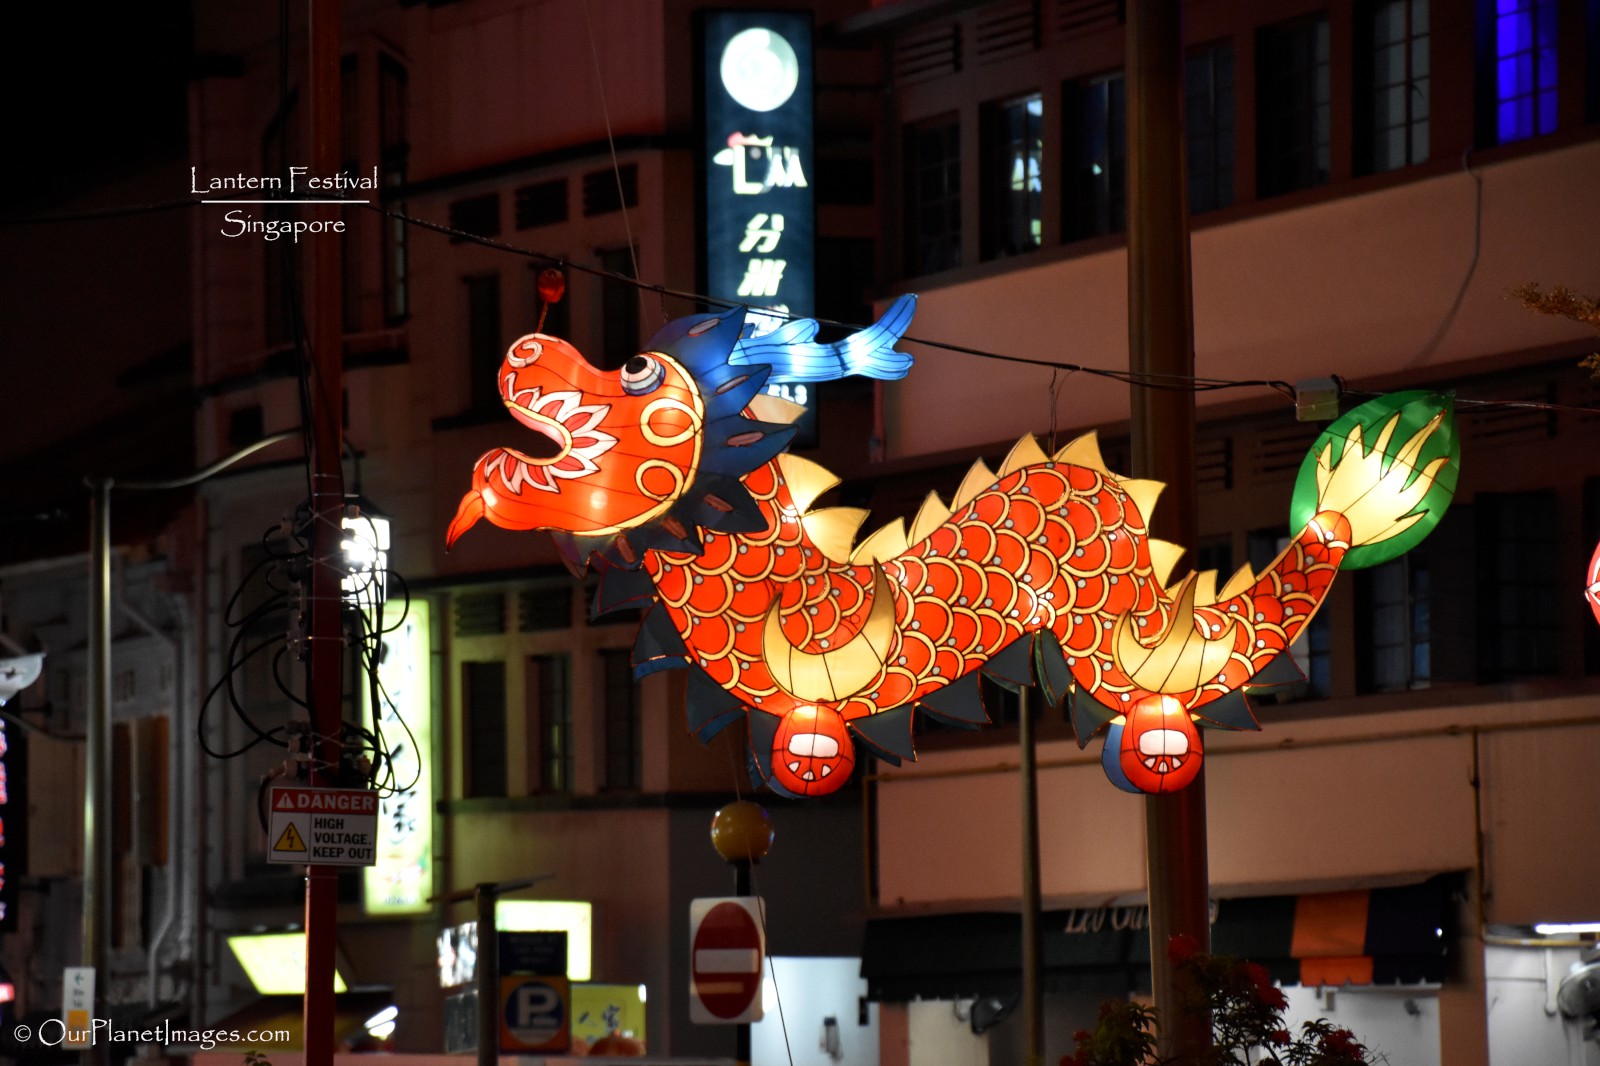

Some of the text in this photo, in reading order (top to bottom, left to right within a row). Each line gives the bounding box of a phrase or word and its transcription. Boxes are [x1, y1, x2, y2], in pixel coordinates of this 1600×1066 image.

[297, 793, 375, 811] DANGER
[314, 817, 344, 830] HIGH
[314, 832, 373, 846] VOLTAGE.
[313, 846, 373, 860] KEEP OUT
[517, 986, 559, 1026] P
